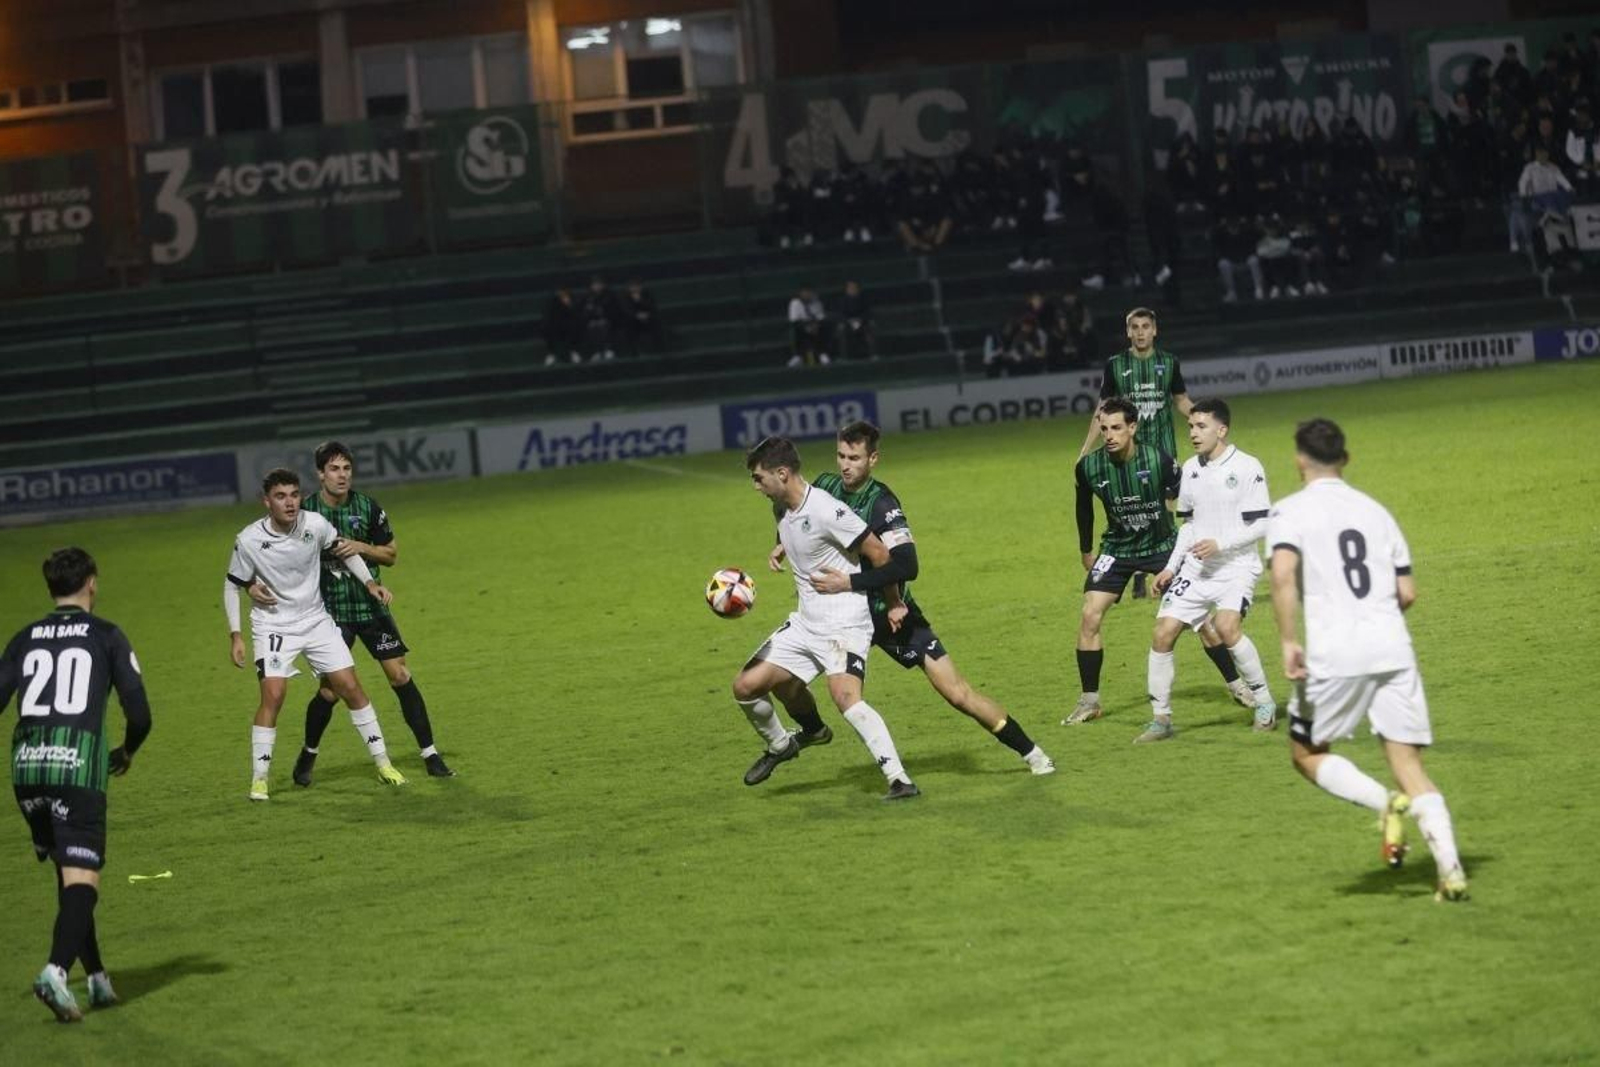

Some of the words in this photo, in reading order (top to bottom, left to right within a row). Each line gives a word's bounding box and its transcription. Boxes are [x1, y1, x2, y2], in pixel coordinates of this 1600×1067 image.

[1206, 66, 1276, 83] MOTOR
[724, 93, 780, 207] 4
[205, 149, 400, 201] AGROMEN
[2, 204, 92, 236] TRO
[144, 148, 198, 265] 3
[901, 407, 932, 432] EL
[949, 394, 1097, 427] CORREO
[518, 412, 688, 471] Andrasa
[0, 465, 175, 502] Rehanor
[1338, 528, 1371, 600] 8
[56, 623, 90, 639] SANZ
[268, 632, 284, 653] 17
[20, 646, 93, 718] 20
[15, 741, 79, 764] Andrasa
